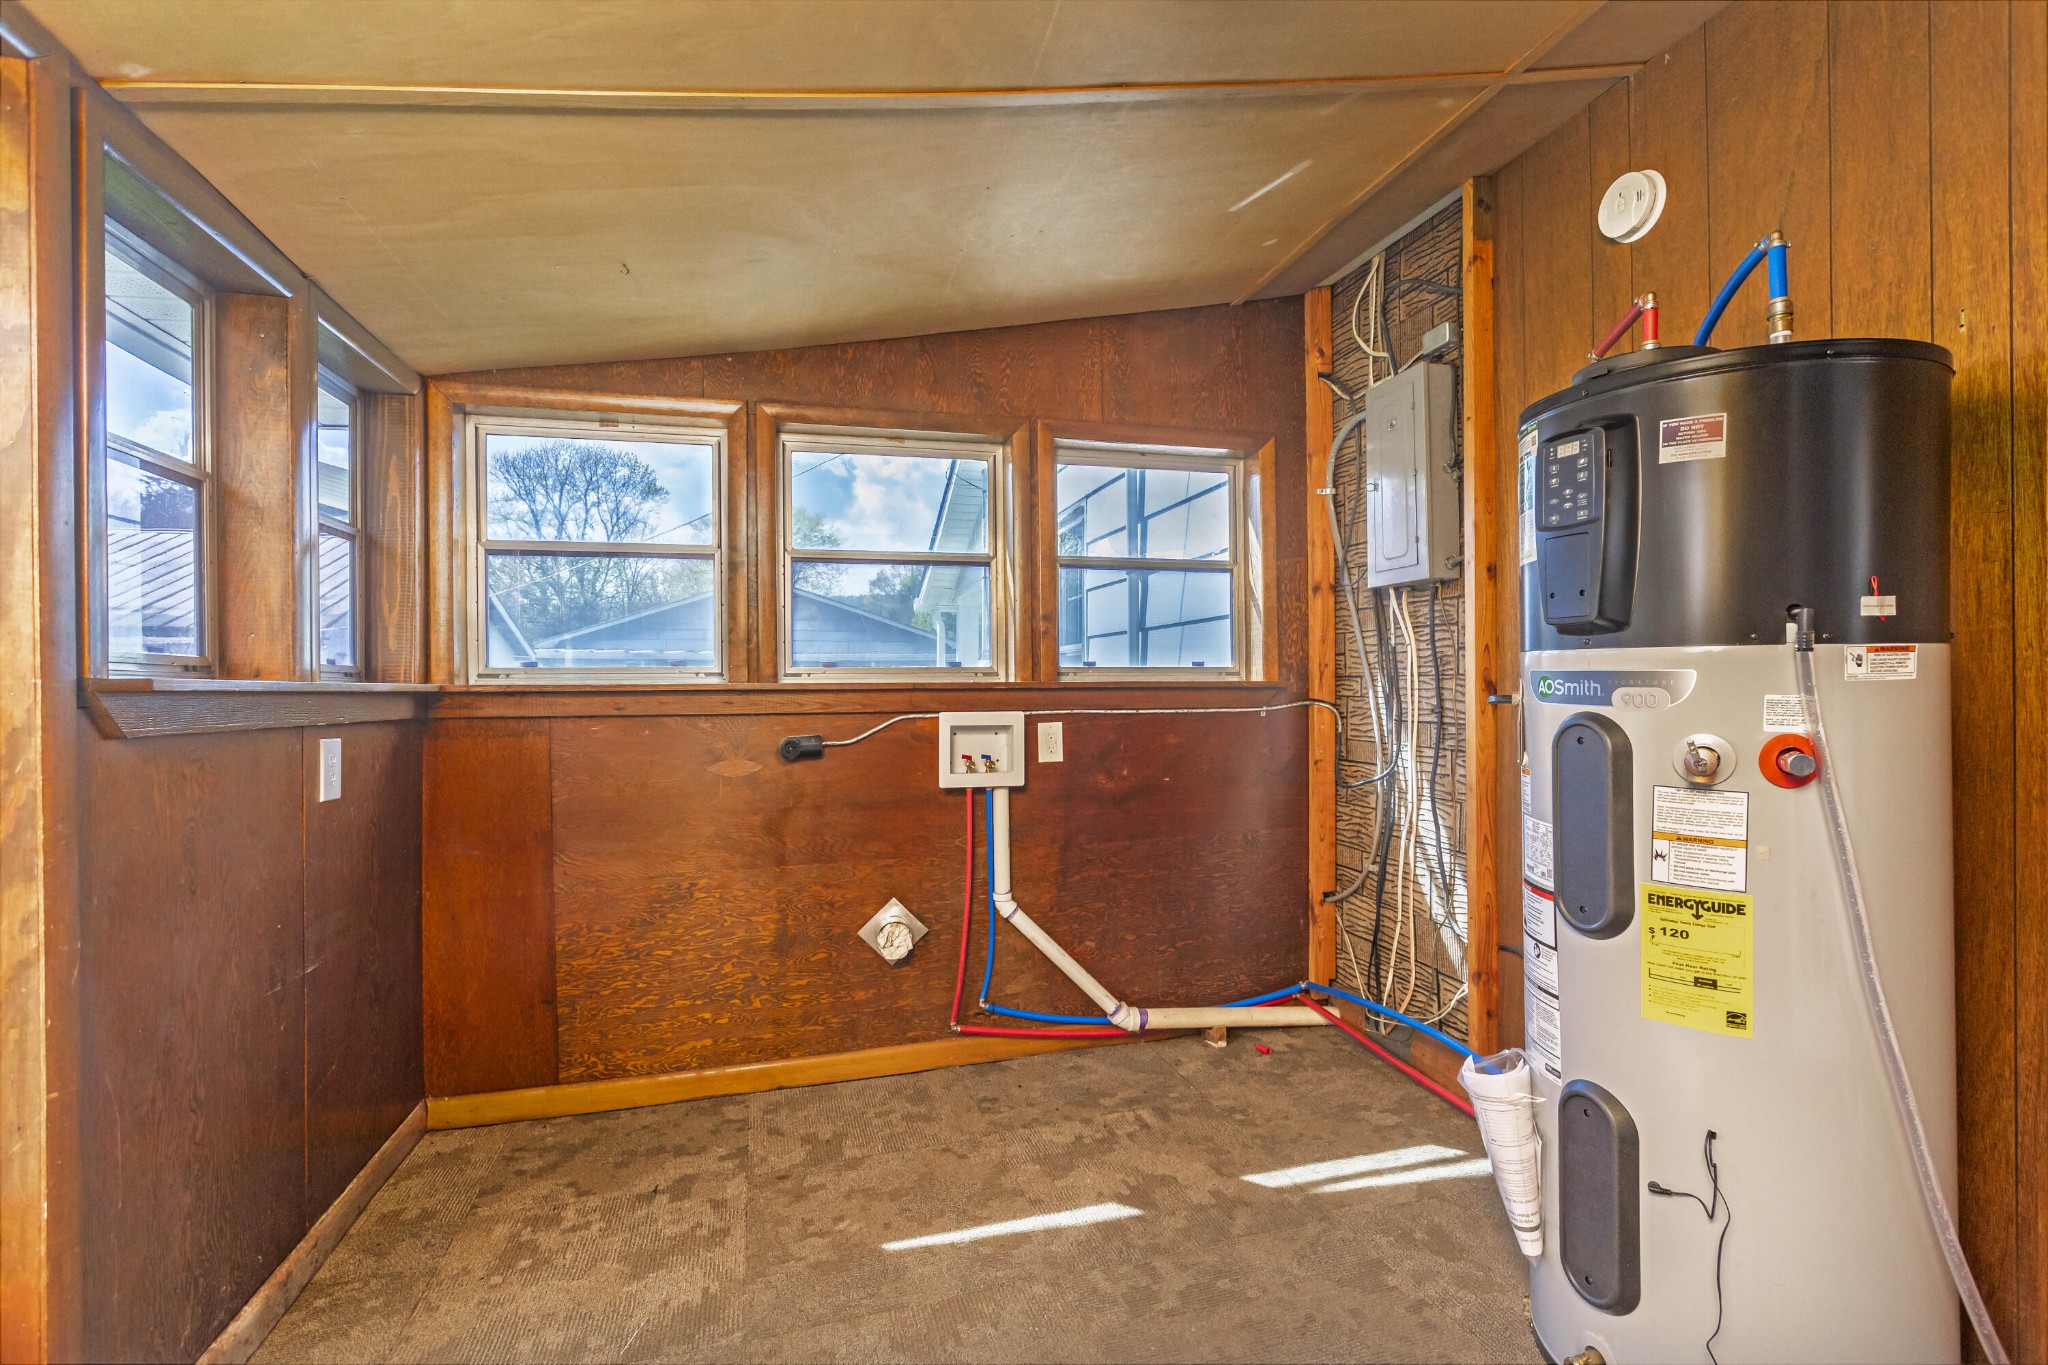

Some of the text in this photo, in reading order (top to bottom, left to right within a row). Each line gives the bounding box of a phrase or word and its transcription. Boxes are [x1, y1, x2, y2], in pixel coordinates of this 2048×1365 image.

[1538, 679, 1601, 697] AOSmith
[1621, 692, 1658, 708] 900
[1682, 837, 1715, 845] WARNING
[1648, 926, 1690, 939] $ 120
[1699, 965, 1717, 973] Rating
